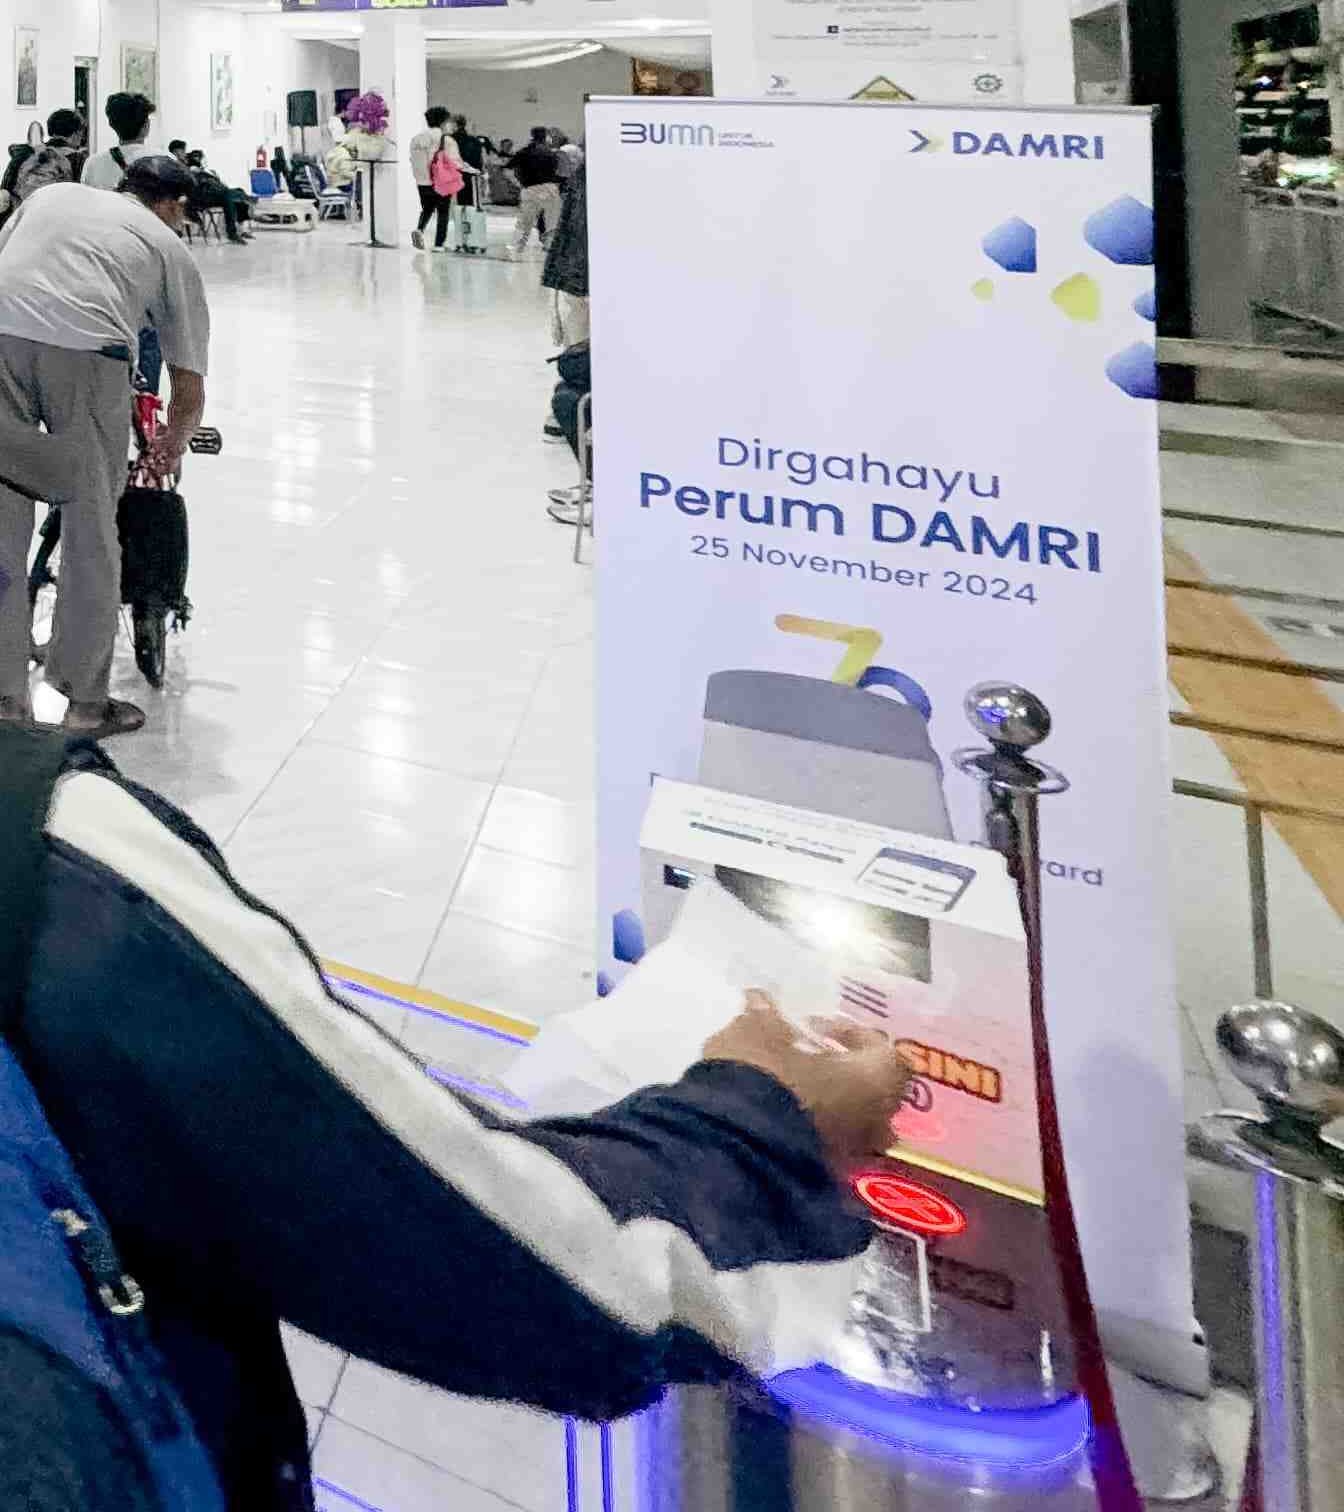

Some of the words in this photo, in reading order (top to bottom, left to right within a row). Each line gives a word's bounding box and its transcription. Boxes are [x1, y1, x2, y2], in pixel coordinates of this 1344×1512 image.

[952, 130, 1105, 160] DAMRI
[718, 437, 1000, 502] Dirgahayu
[640, 472, 844, 536] Perum
[872, 503, 1103, 573] DAMRI
[690, 534, 729, 559] 25
[742, 541, 930, 589] November
[944, 570, 1038, 605] 2024
